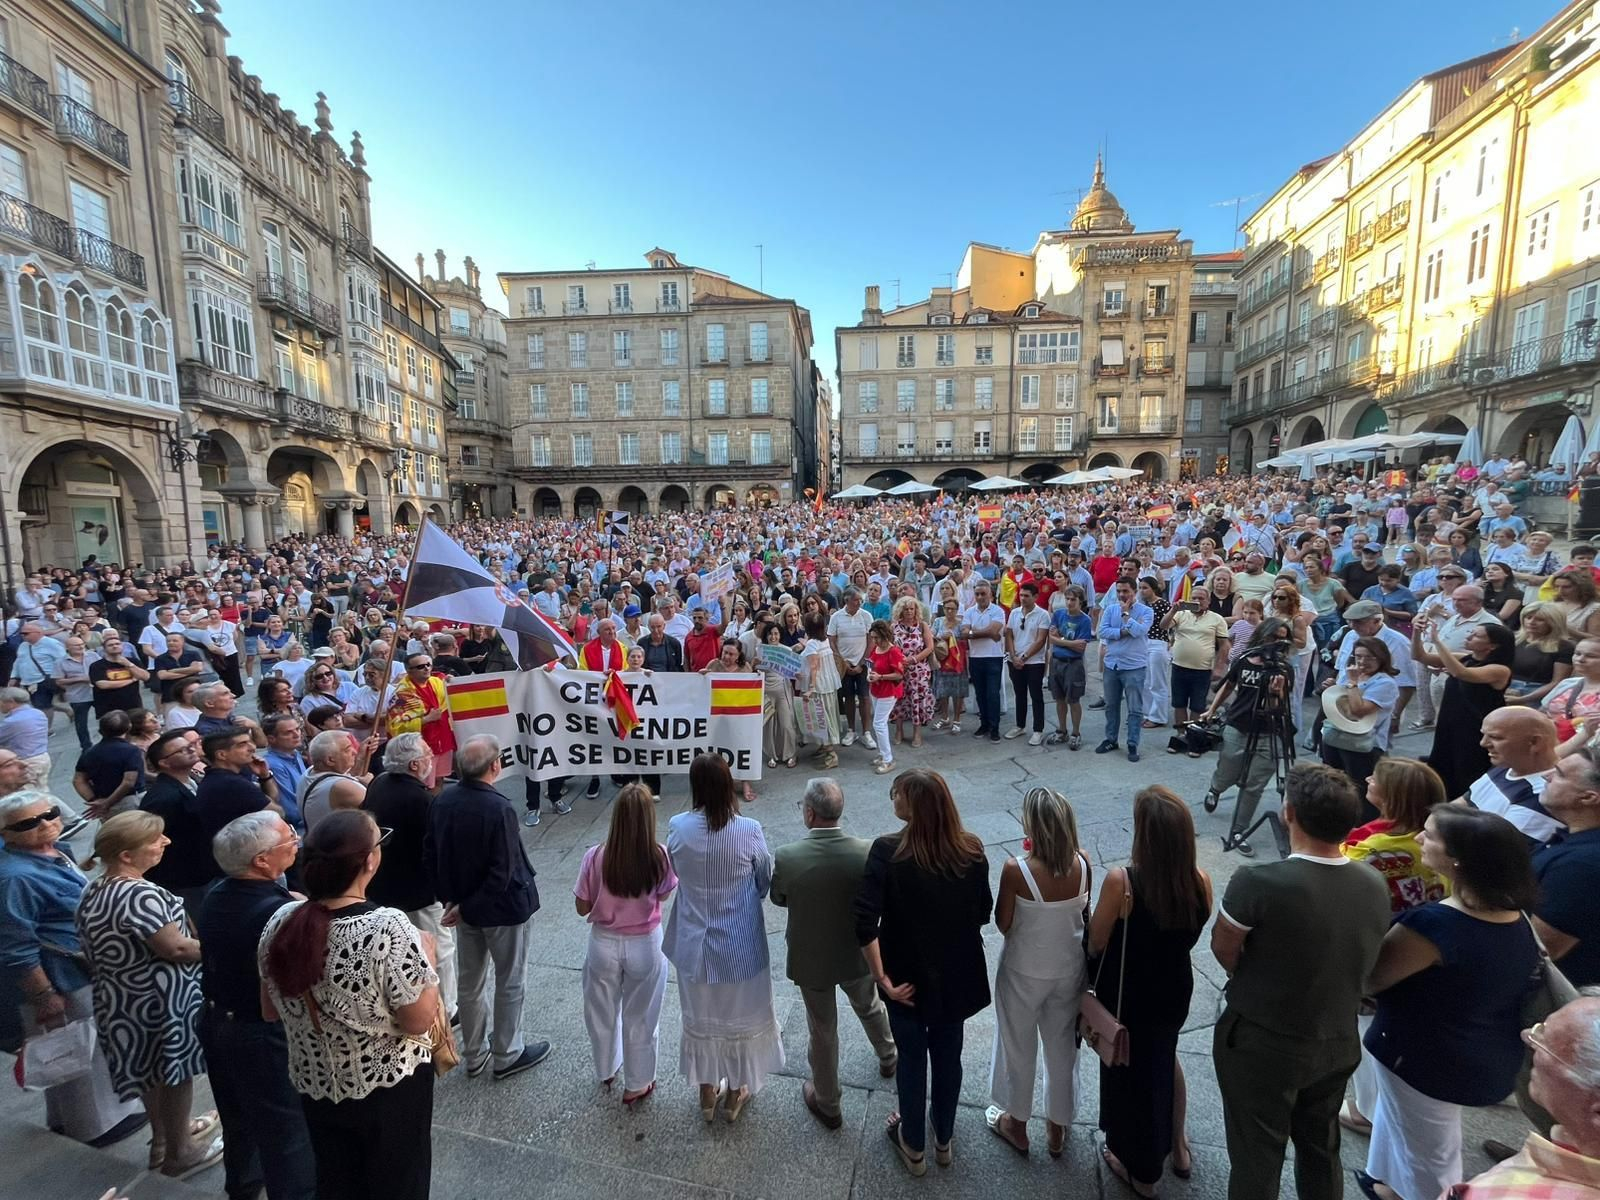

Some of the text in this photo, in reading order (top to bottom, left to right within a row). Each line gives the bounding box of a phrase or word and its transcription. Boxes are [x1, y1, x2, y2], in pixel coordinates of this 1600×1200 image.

[560, 681, 658, 706] CETA
[516, 712, 556, 736] NO
[565, 713, 599, 735] SE
[500, 744, 559, 771] EUTA
[568, 744, 602, 765] SE
